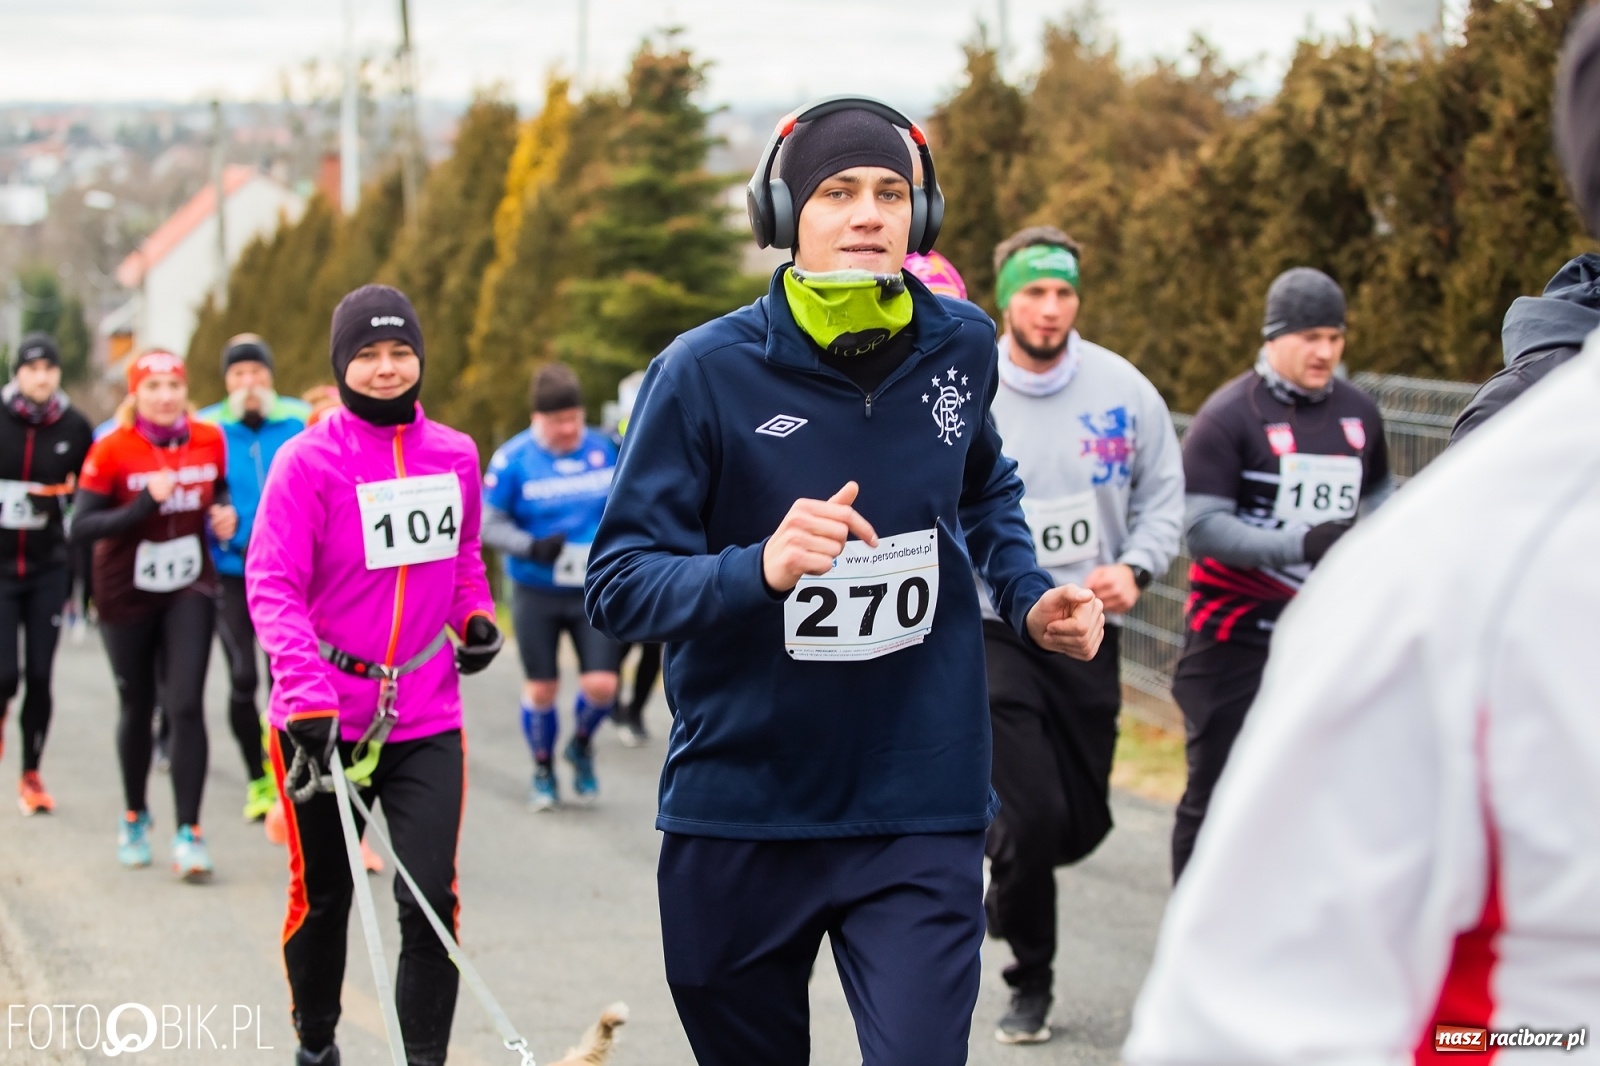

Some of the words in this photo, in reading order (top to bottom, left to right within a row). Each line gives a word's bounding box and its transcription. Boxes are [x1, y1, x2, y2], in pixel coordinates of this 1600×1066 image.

[1289, 482, 1355, 512] 185
[374, 505, 457, 549] 104
[1042, 519, 1090, 552] 60
[142, 556, 195, 579] 412
[845, 543, 932, 565] www.personalbest.pl
[795, 576, 930, 638] 270
